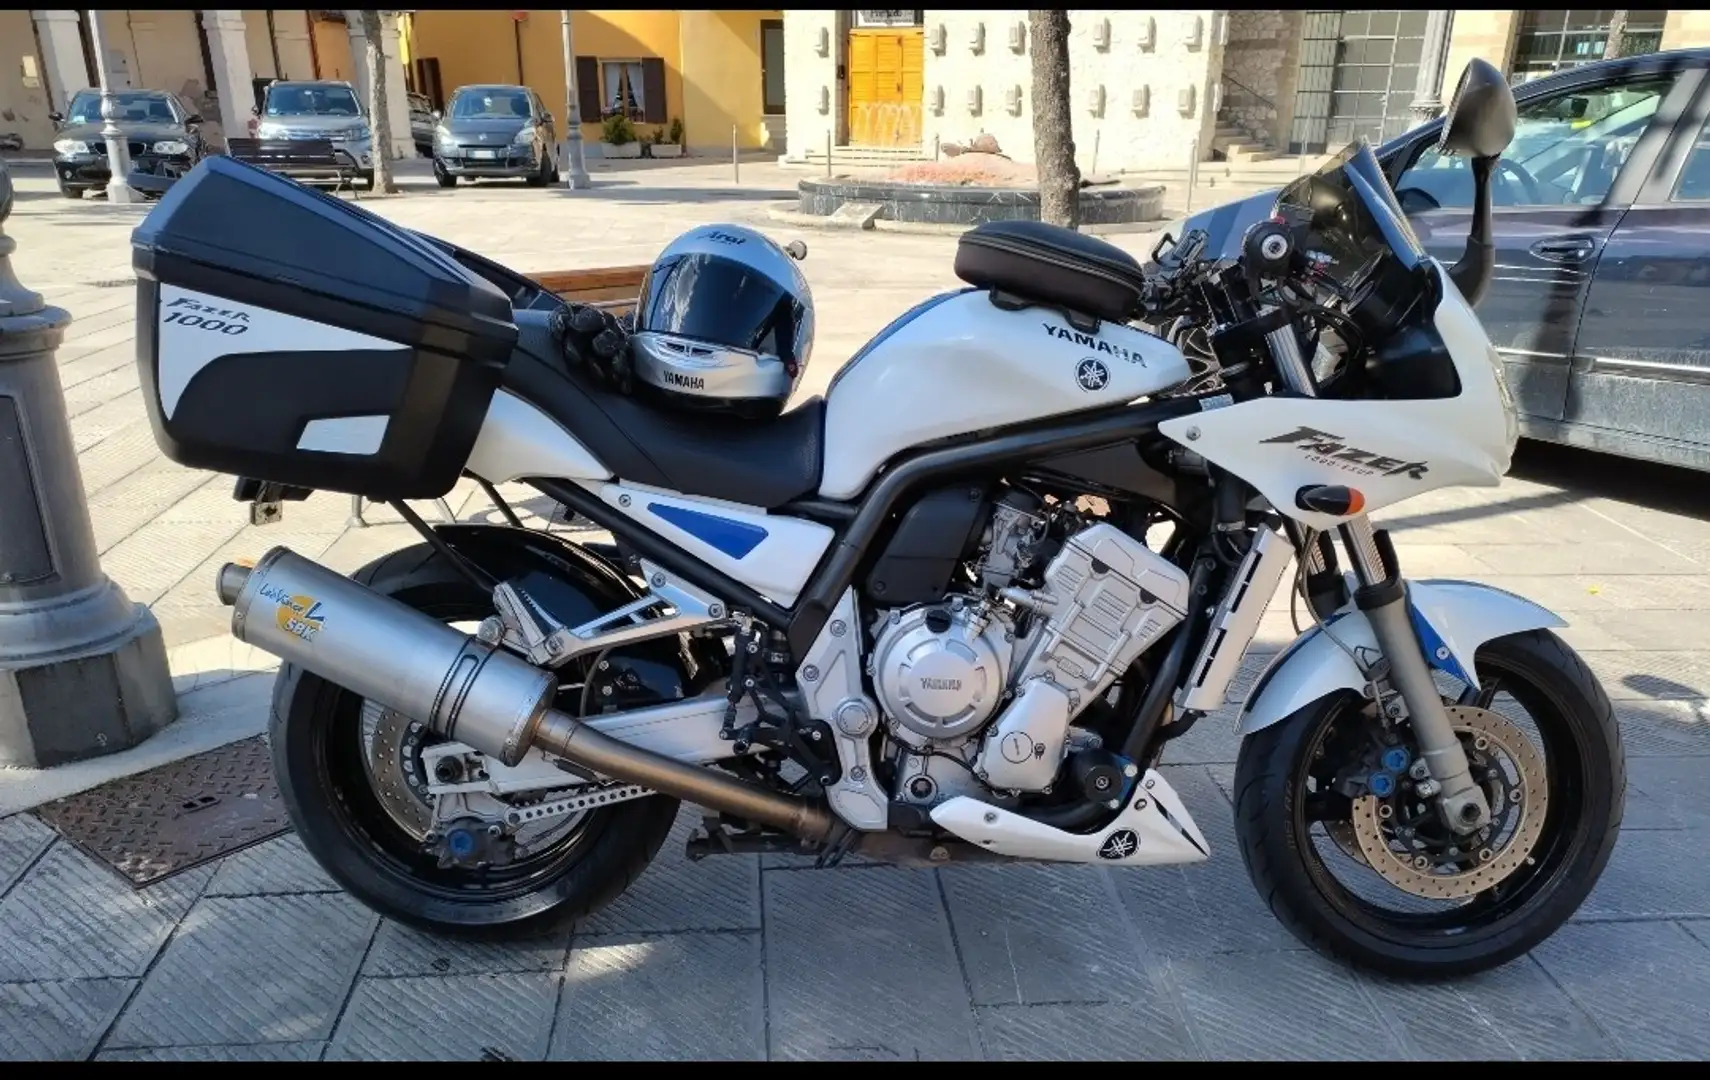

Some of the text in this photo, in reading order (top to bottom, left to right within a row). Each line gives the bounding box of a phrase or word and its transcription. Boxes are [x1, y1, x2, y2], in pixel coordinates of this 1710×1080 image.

[164, 312, 248, 335] 1000
[1043, 323, 1147, 368] YAMAHA
[664, 370, 704, 390] YAMAHA
[1259, 426, 1429, 480] FAZER
